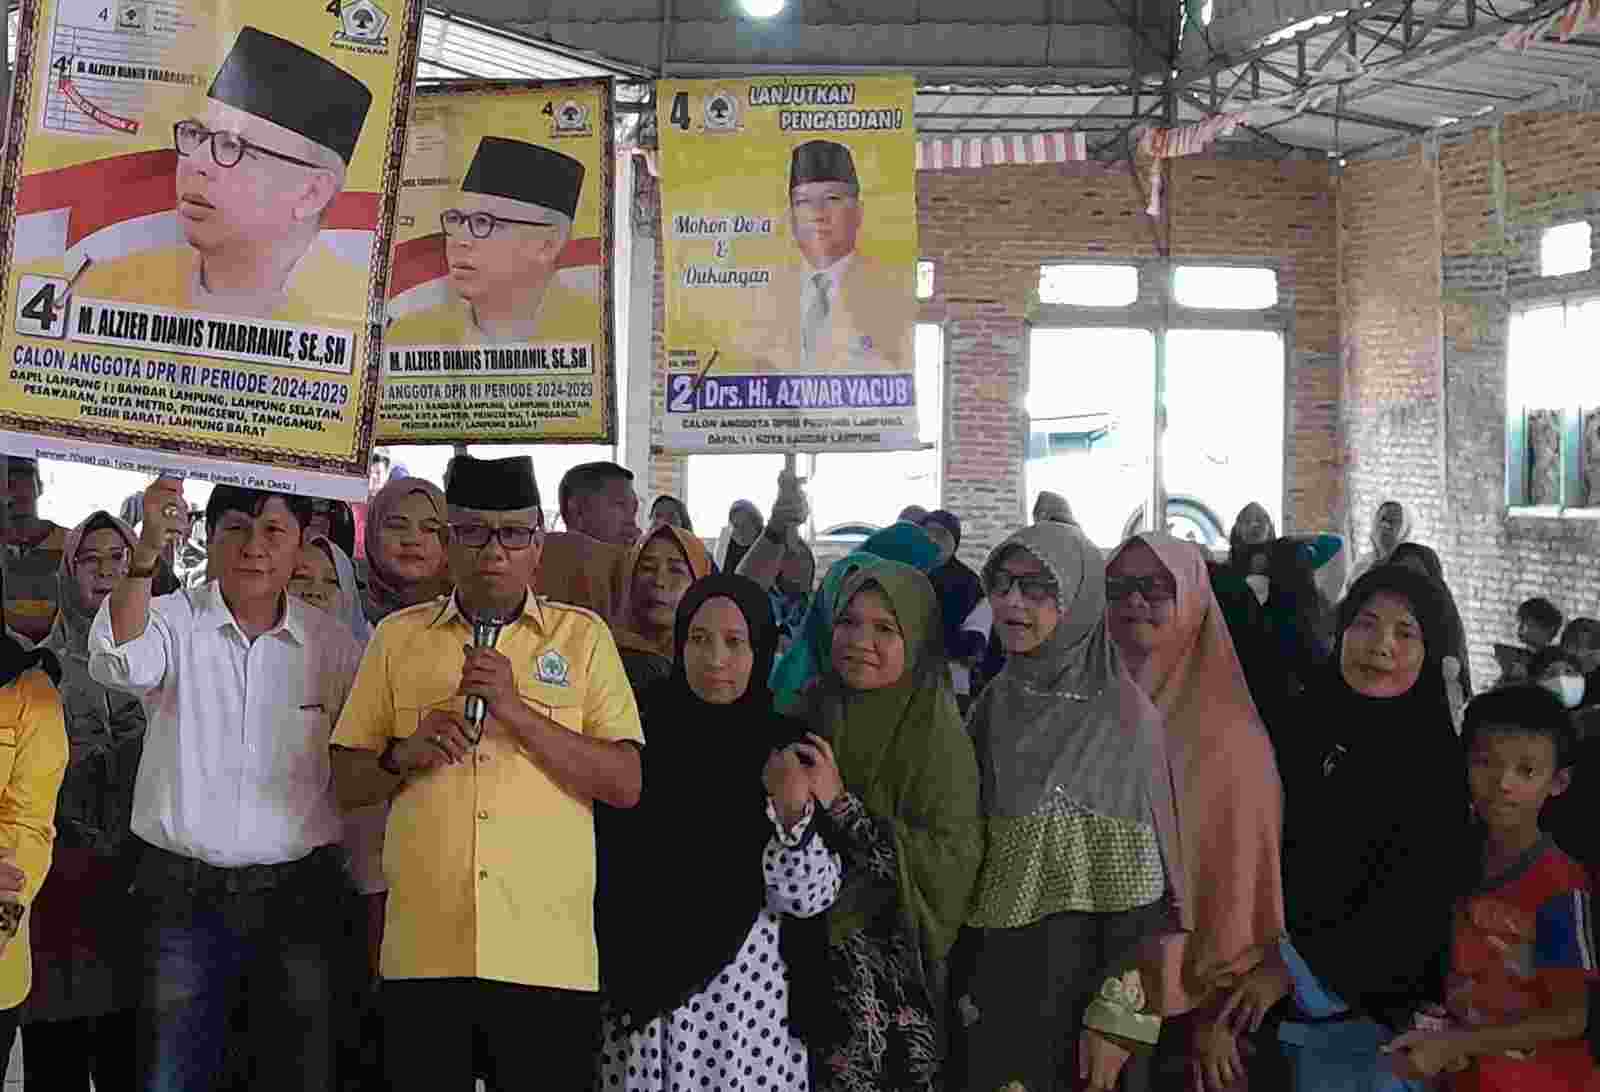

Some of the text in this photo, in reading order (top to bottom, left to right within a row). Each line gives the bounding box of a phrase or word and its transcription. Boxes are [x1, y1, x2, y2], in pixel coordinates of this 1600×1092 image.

[98, 8, 109, 21] 4
[54, 56, 67, 72] 4
[749, 82, 855, 106] LANJUTKAN
[541, 101, 554, 117] 4
[670, 92, 690, 130] 4
[780, 109, 903, 130] PENGABDIAN!
[674, 215, 728, 233] Mohon
[715, 240, 729, 257] &
[683, 264, 769, 287] Dukungan
[21, 283, 57, 331] 4
[78, 305, 95, 335] M.
[98, 309, 148, 342] ALZIER
[150, 314, 204, 348] DIANIS
[207, 320, 295, 361] THABRANIE,
[389, 351, 402, 371] M.
[405, 351, 441, 371] ALZIER
[444, 350, 481, 370] DIANIS
[14, 345, 348, 405] CALON ANGGOTA DPR RI PERIODE 2024-2029
[10, 370, 42, 383] DAPIL
[46, 373, 105, 391] LAMPUNG
[119, 383, 166, 398] BANDAR
[170, 388, 228, 407] LAMPUNG,
[231, 397, 286, 413] LAMPUNG
[289, 403, 344, 422] SELATAN,
[24, 384, 97, 404] PESAWARAN,
[101, 395, 132, 408] KOTA
[136, 398, 177, 414] METRO,
[388, 383, 441, 400] ANGGOTA
[444, 383, 466, 400] DPR
[484, 382, 533, 399] PERIODE
[536, 382, 592, 398] 2024-2029
[670, 375, 693, 411] 2
[704, 377, 908, 407] Drs. Hi. AZWAR YACUB
[123, 409, 165, 426] BARAT,
[169, 414, 224, 431] LAMPUNG
[226, 423, 267, 438] BARAT
[682, 418, 717, 428] CALON
